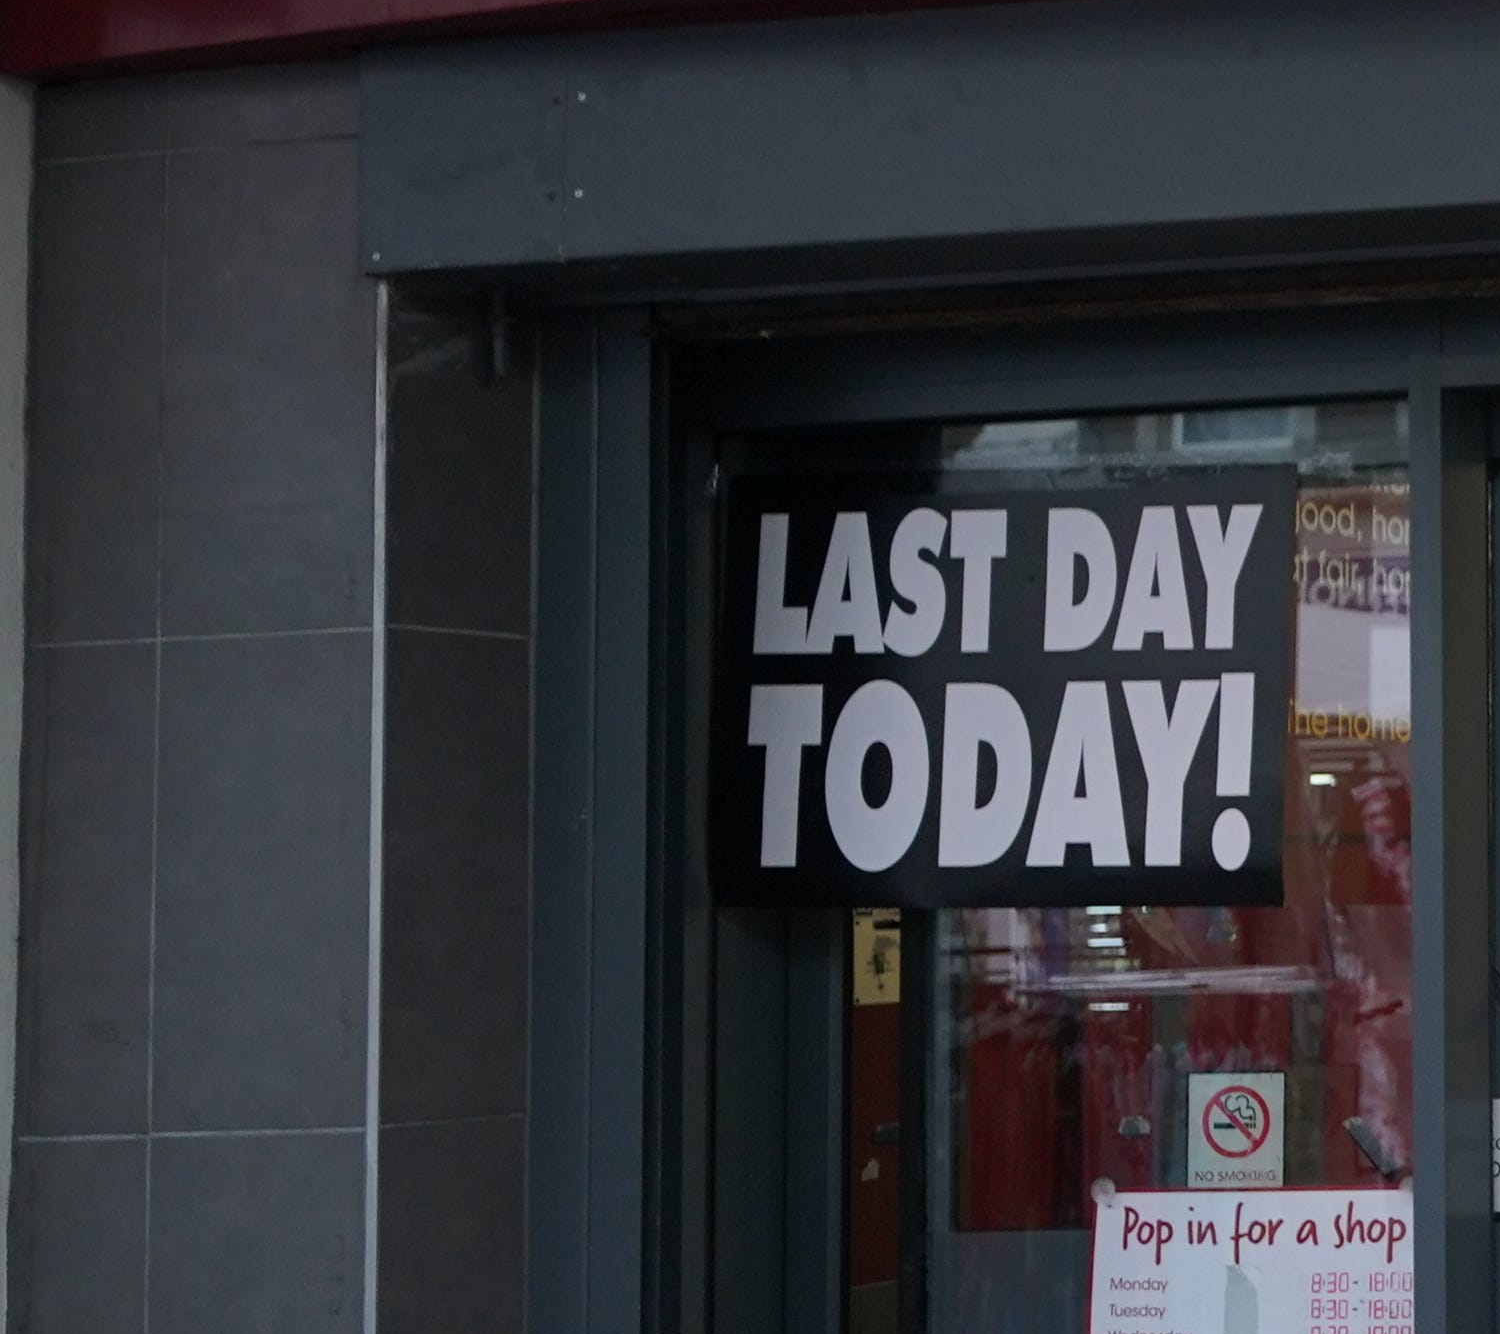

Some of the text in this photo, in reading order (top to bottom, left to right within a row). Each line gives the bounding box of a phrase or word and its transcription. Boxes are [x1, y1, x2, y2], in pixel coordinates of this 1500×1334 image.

[753, 504, 1263, 657] LAST DAY
[747, 672, 1255, 873] TODAY!
[1194, 1170, 1276, 1182] NO SMOKING
[1122, 1200, 1407, 1266] Pop in for a shop
[1110, 1278, 1168, 1293] Monday
[1109, 1304, 1166, 1319] Tuesday
